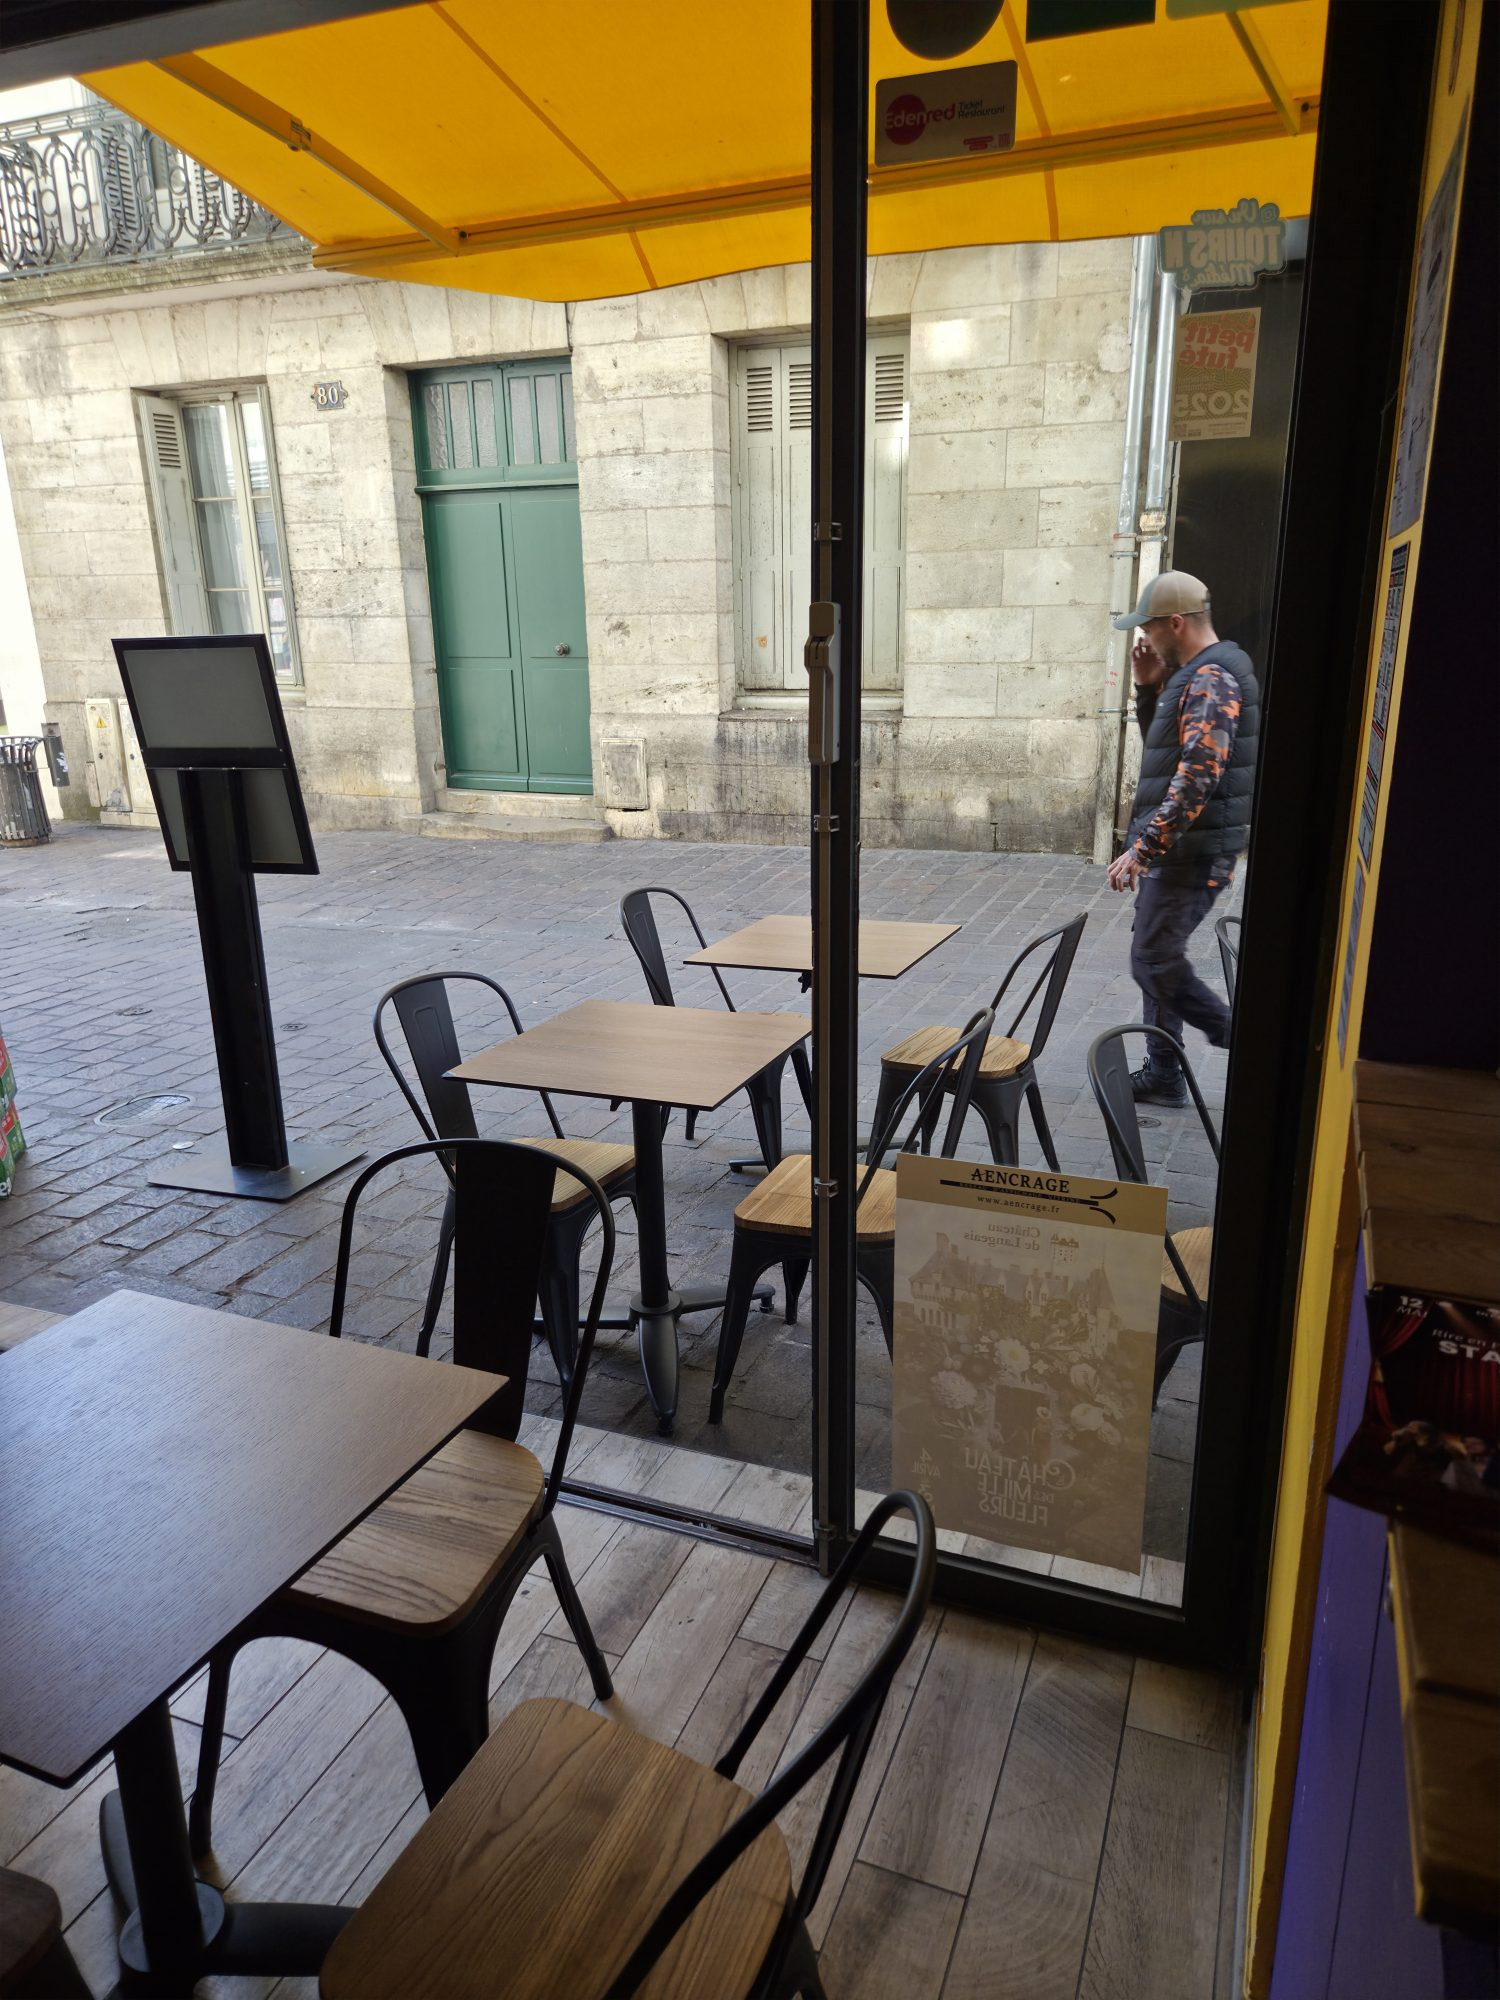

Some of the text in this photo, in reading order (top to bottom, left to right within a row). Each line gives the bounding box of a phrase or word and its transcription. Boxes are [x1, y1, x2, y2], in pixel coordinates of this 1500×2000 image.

[885, 103, 956, 129] Edenred
[957, 105, 1005, 119] Restaurant
[318, 386, 339, 405] 80
[971, 1168, 1070, 1194] AENCRAGE
[977, 1196, 1060, 1214] www.aencrage.fr
[1400, 1295, 1423, 1309] 12
